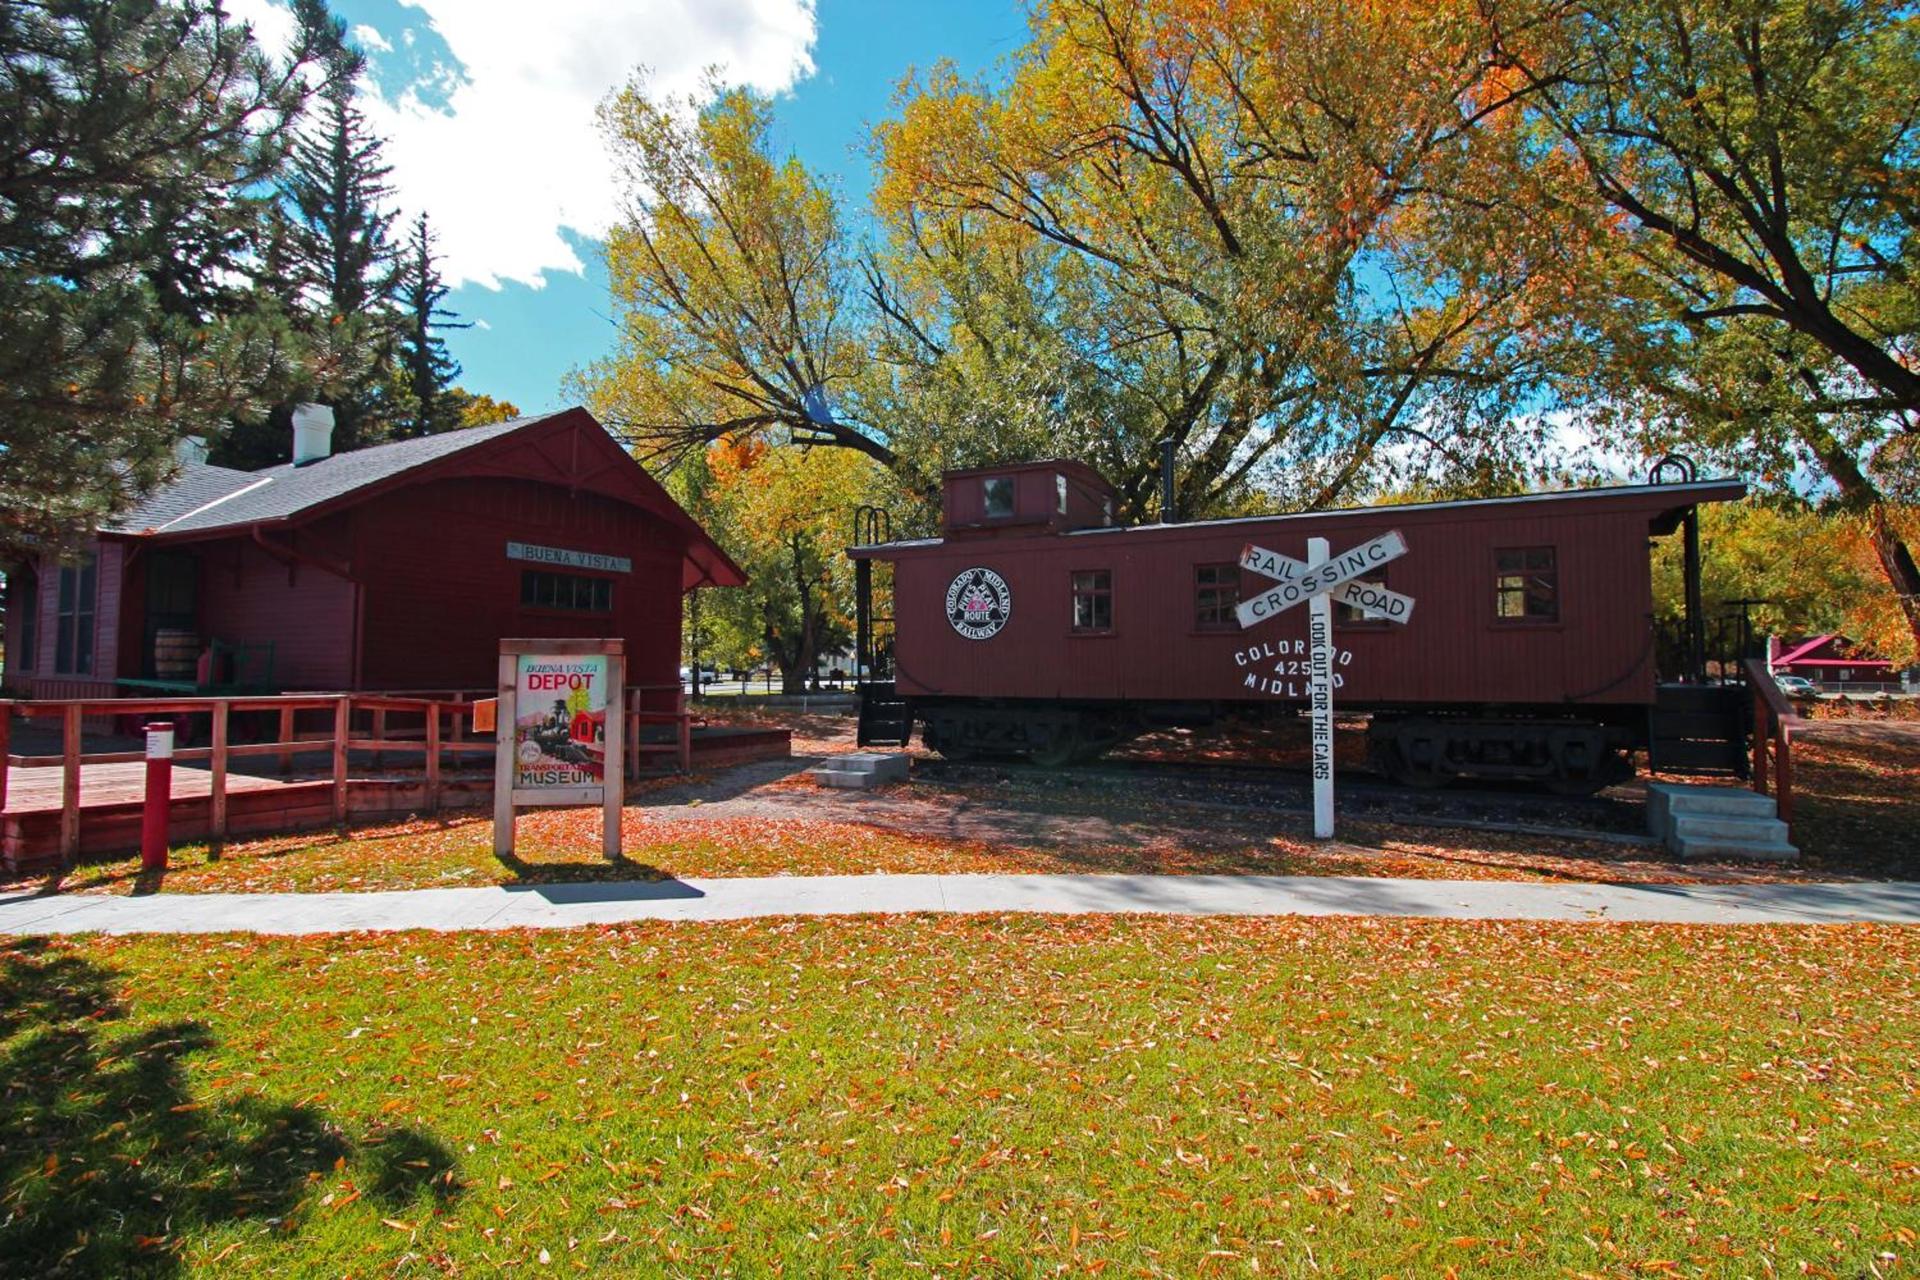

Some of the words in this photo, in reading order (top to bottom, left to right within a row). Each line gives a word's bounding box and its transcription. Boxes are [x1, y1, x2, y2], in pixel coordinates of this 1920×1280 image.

[524, 545, 571, 564] BUENA
[577, 553, 617, 570] VISTA
[947, 571, 973, 614] COLORADO
[985, 571, 1008, 613] MIDLAND
[1246, 551, 1294, 580] RAIL
[1345, 583, 1405, 617] ROAD
[1251, 543, 1387, 617] CROSSING
[978, 584, 997, 611] PEAK
[964, 611, 990, 620] ROUTE
[957, 623, 996, 637] RAILWAY
[1311, 613, 1326, 648] LOOK
[1235, 640, 1352, 666] COLORO
[1312, 652, 1327, 679] OUT
[528, 674, 594, 690] DEPOT
[1244, 673, 1344, 697] MIDLD
[1313, 683, 1328, 710] FOR
[1314, 714, 1328, 740] THE
[1314, 743, 1329, 780] CARS
[520, 771, 595, 784] MUSEUM
